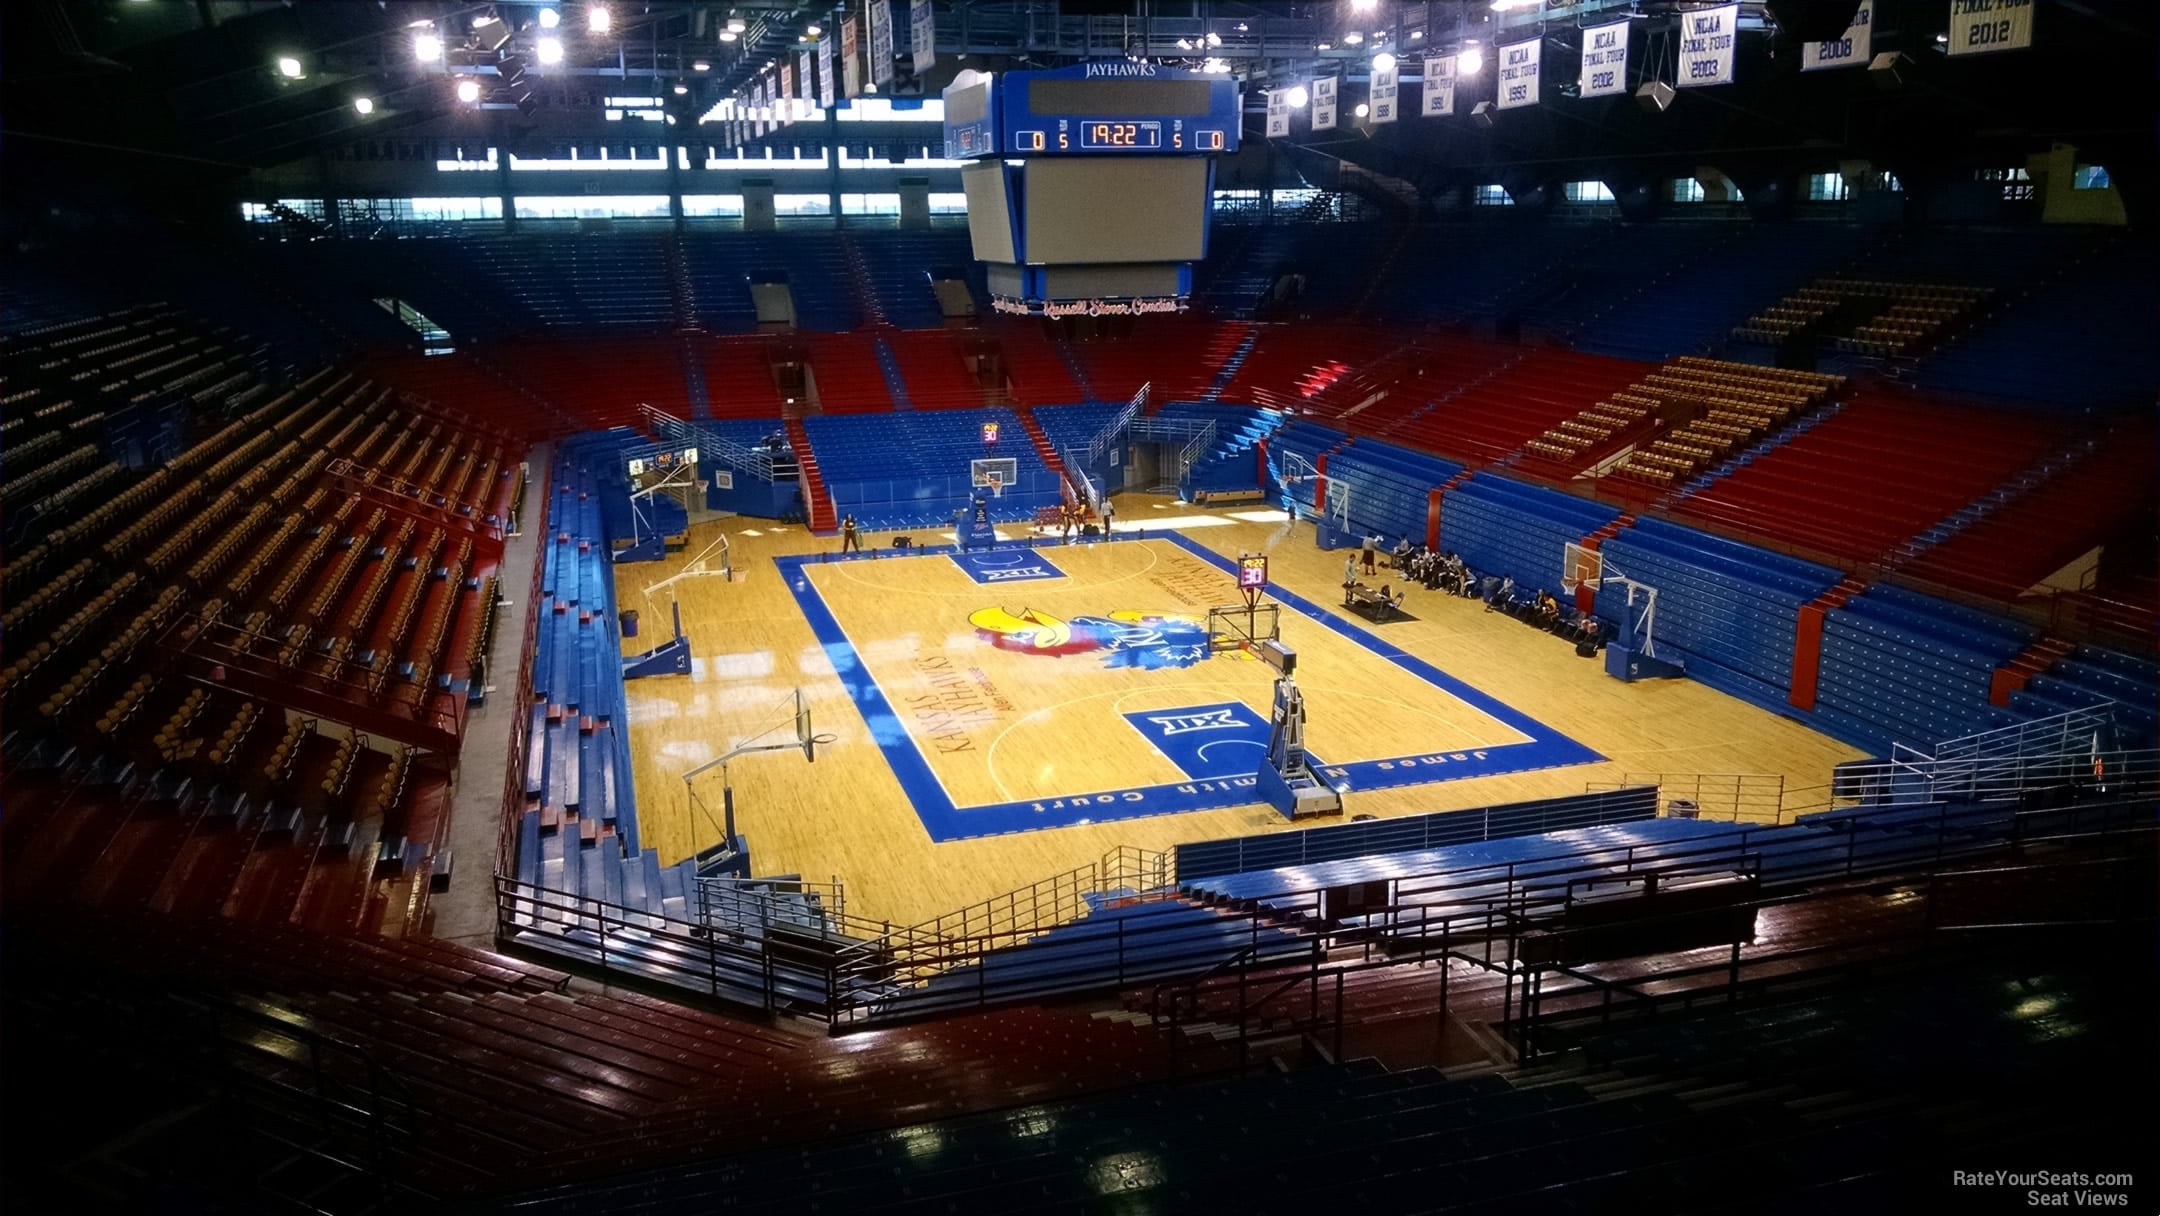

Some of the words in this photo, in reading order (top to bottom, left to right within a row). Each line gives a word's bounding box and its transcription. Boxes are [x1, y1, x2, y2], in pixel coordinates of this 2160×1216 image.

[1694, 16, 1721, 35] NCAA
[1969, 21, 2010, 46] 2012
[1594, 31, 1616, 49] NCAA
[1682, 37, 1706, 53] FINAL
[1709, 34, 1731, 51] FOUR
[1819, 38, 1852, 61] 2008
[1508, 48, 1529, 65] NCAA
[1584, 52, 1604, 67] FINAL
[1606, 48, 1625, 63] FOUR
[1085, 63, 1156, 79] JAYHAWKS
[1501, 66, 1519, 81] FINAL
[1520, 63, 1537, 79] FOUR
[1691, 59, 1718, 78] 2003
[1592, 71, 1614, 89] 2002
[1508, 84, 1527, 101] 1993
[1033, 131, 1044, 149] 0
[1092, 125, 1136, 145] 19:22
[1150, 131, 1155, 145] 1
[1211, 131, 1222, 149] 0
[1043, 300, 1088, 320] Russell
[1089, 299, 1131, 318] Stover
[1132, 298, 1177, 316] Candies
[985, 431, 997, 441] 30
[1244, 568, 1262, 584] 30
[914, 656, 1006, 724] JAYHAWKS
[904, 695, 976, 755] KANSAS
[1377, 751, 1489, 770] James
[1031, 791, 1144, 813] Court
